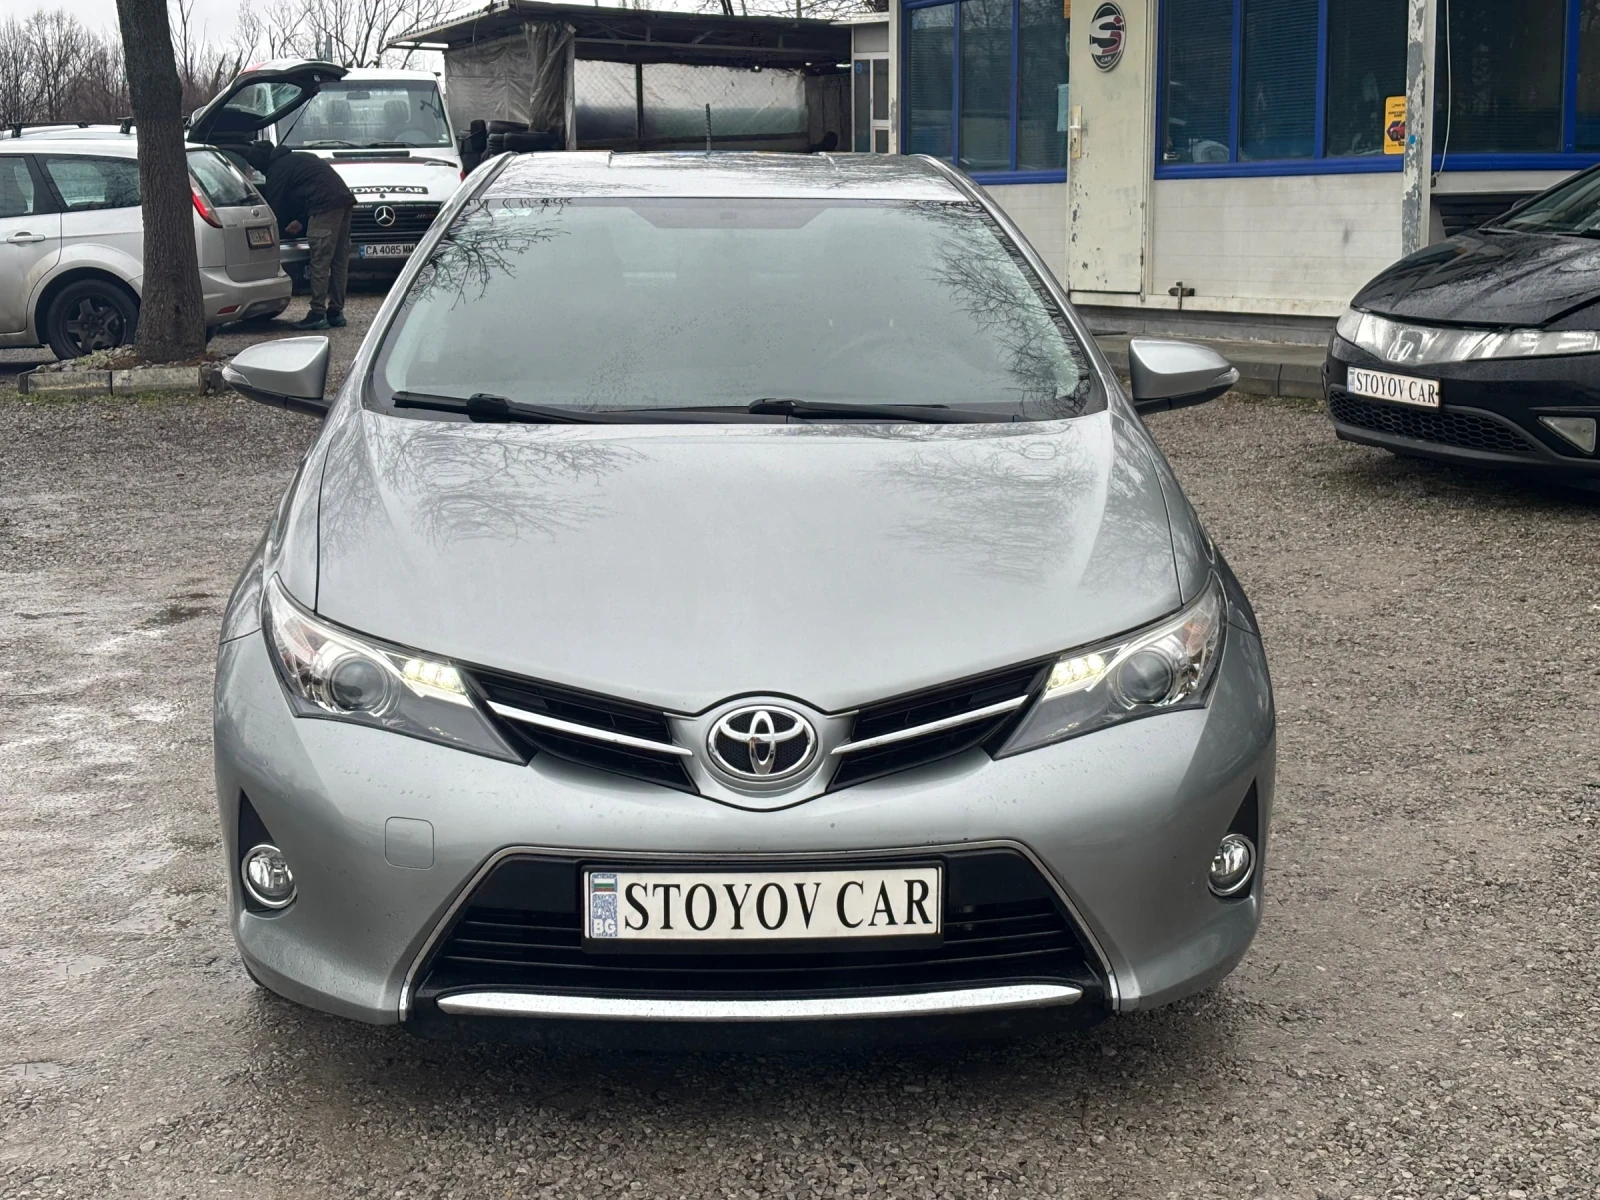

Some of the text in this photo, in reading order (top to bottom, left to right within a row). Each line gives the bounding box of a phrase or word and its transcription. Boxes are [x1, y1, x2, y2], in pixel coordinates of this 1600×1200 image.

[365, 246, 378, 255] CA
[379, 245, 402, 255] 4085
[1356, 372, 1436, 404] STOYOV CAR
[624, 879, 933, 931] STOYOV CAR
[593, 918, 617, 934] BG
